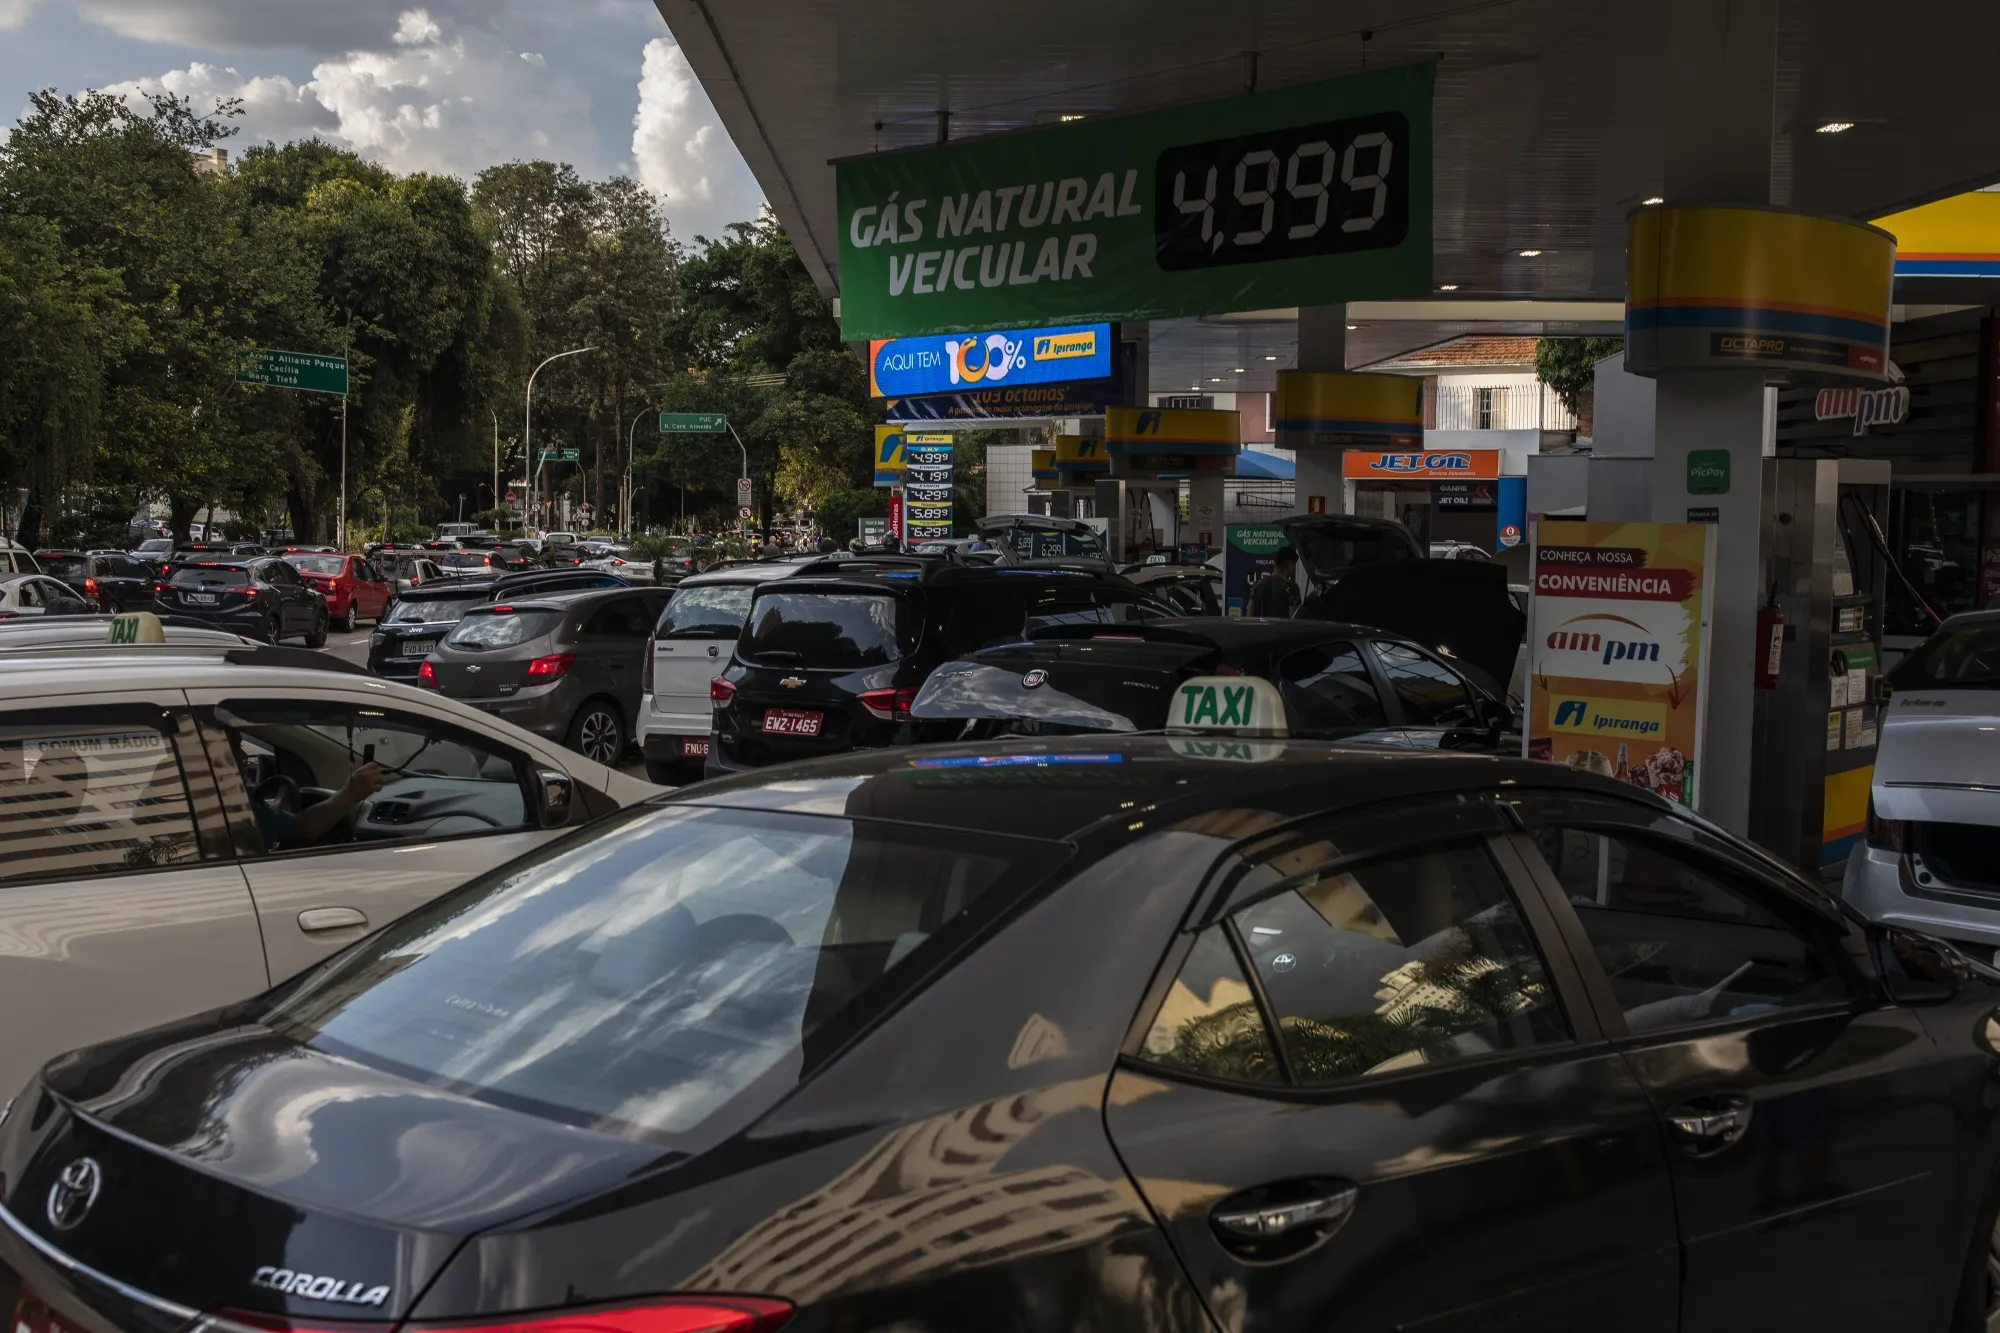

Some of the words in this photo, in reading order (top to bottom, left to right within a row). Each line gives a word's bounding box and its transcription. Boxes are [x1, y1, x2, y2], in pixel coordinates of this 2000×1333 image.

[1172, 131, 1394, 256] 4,999
[850, 190, 928, 249] GÁS
[936, 169, 1142, 239] NATURAL
[889, 233, 1098, 297] VEICULAR
[1720, 337, 1784, 352] OCTAPRO
[269, 364, 299, 374] Cecília
[279, 355, 311, 366] Allianz
[314, 359, 345, 370] Parque
[883, 353, 914, 372] AQUI
[916, 351, 941, 369] TEM
[945, 334, 1026, 385] 100%
[1053, 340, 1093, 355] Ipiranga
[276, 375, 298, 384] Tietê
[1370, 453, 1424, 471] JET
[1424, 452, 1472, 470] OIL
[1691, 466, 1725, 478] PicPay
[1236, 528, 1251, 539] GÁS
[1252, 530, 1287, 539] NATURAL
[1243, 538, 1279, 546] VEICULAR
[1540, 549, 1591, 564] CONHEÇA
[1597, 552, 1634, 564] NOSSA
[1538, 572, 1672, 595] CONVENIÊNCIA
[112, 617, 140, 644] TAXI
[1180, 685, 1255, 726] TAXI
[1593, 714, 1660, 734] Ipiranga
[38, 738, 103, 752] COMUM
[109, 733, 160, 750] RÁDIO
[249, 1265, 392, 1306] COROLLA
